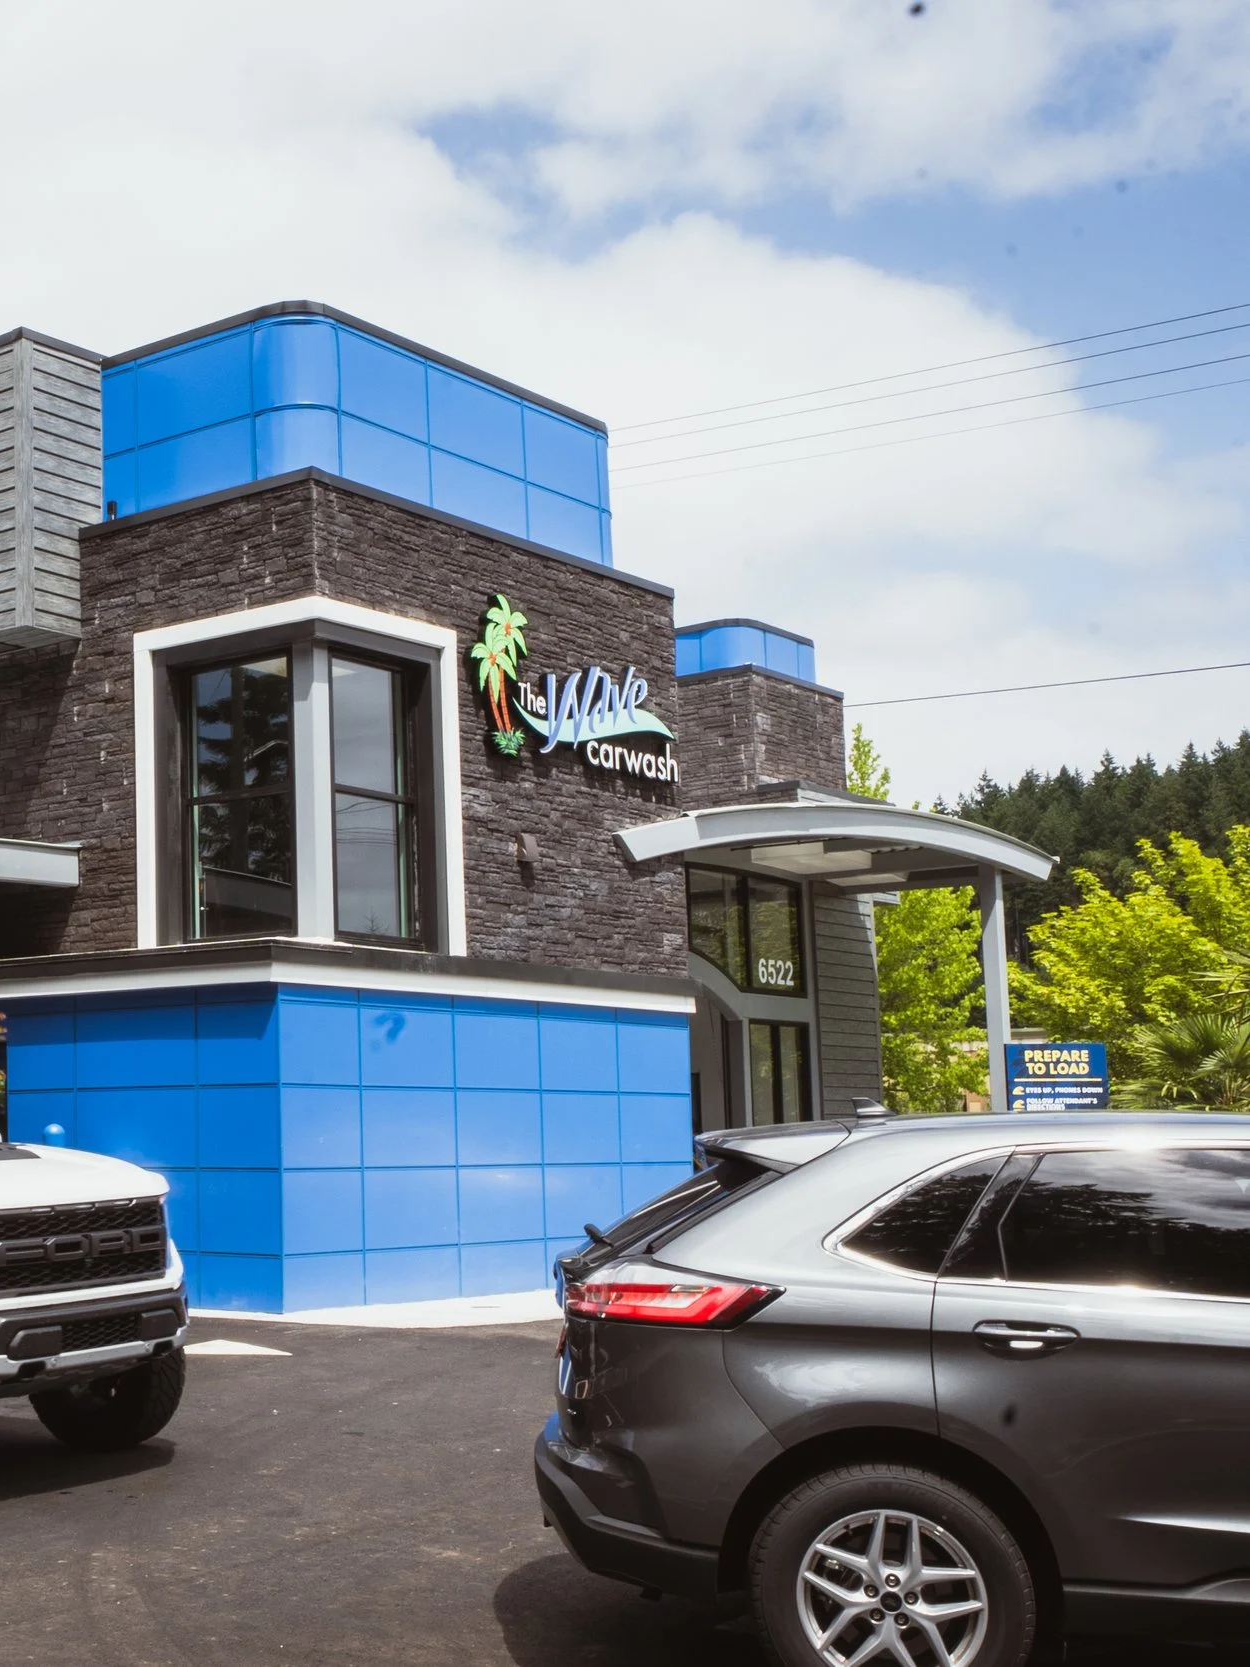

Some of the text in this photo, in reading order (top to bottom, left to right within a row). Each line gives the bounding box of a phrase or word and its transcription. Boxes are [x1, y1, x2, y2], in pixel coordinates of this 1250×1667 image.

[518, 666, 648, 754] The Wave
[587, 740, 680, 783] carwash
[758, 958, 794, 986] 6522
[1024, 1050, 1089, 1061] PREPARE
[1026, 1063, 1089, 1074] TO LOAD
